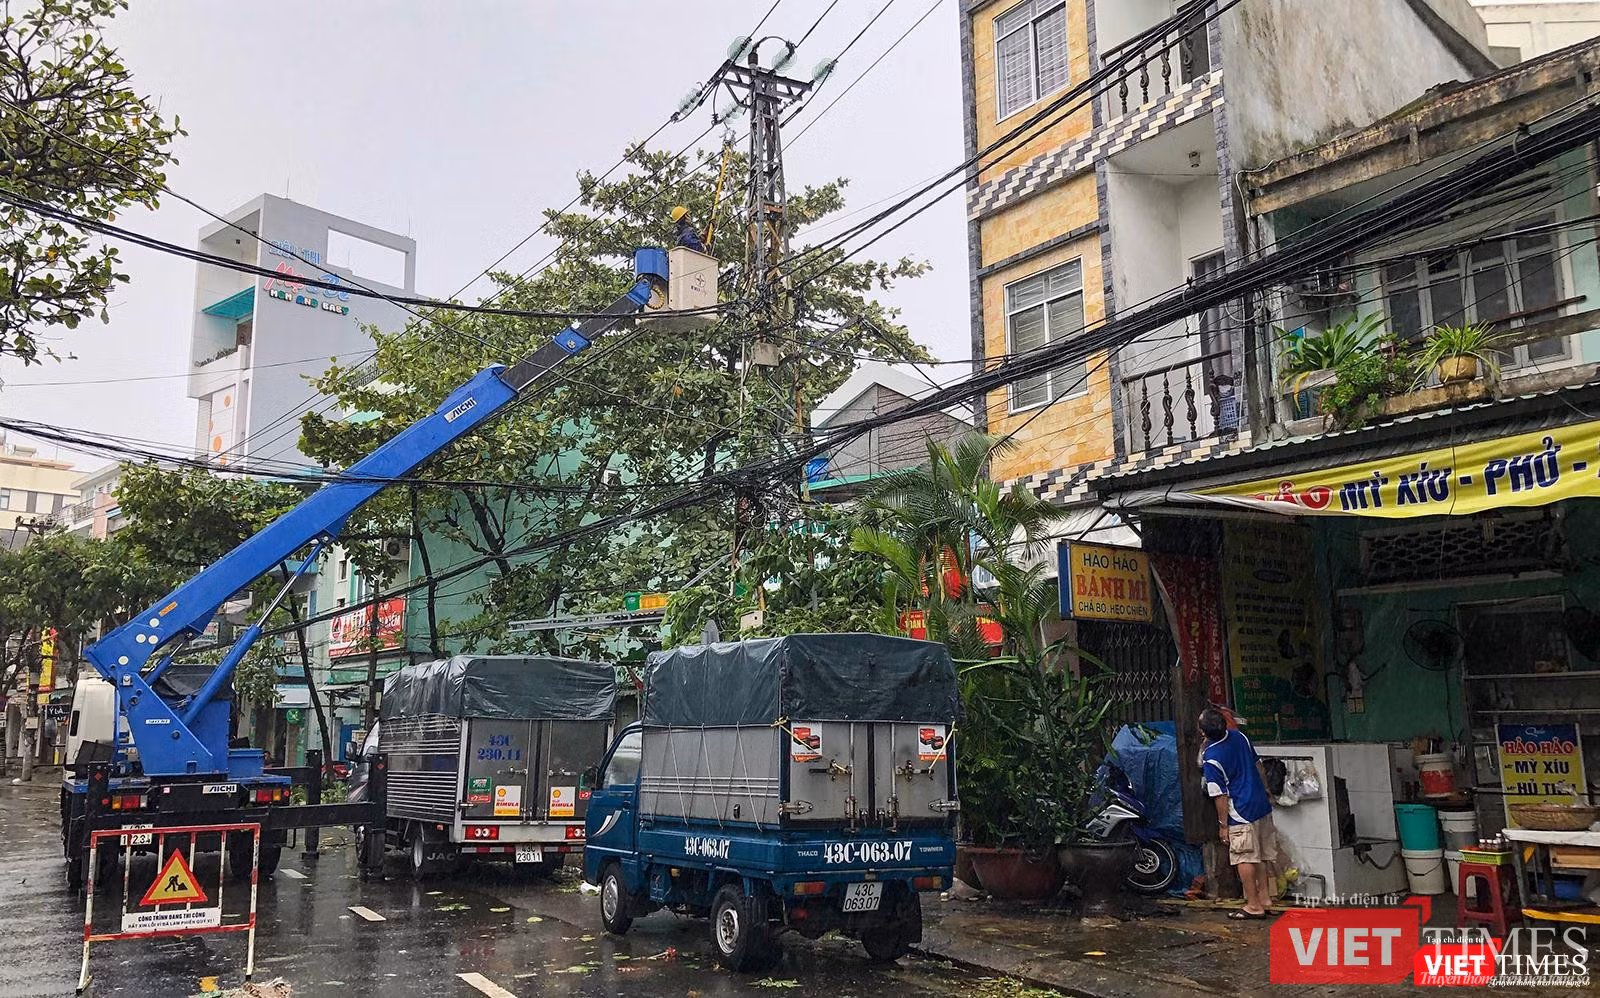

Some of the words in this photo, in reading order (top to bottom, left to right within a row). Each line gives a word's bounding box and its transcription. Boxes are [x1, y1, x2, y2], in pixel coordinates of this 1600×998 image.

[269, 289, 293, 302] MOM
[296, 295, 319, 308] AND
[322, 302, 349, 316] BABY
[447, 399, 476, 420] AICHI
[1397, 463, 1452, 506] XÍU
[1486, 436, 1562, 496] PHỞ
[478, 748, 521, 760] 230.11
[1515, 759, 1538, 774] MỲ
[1543, 759, 1569, 774] XÍU
[207, 785, 236, 793] AICHI
[1517, 778, 1538, 795] HỦ
[684, 837, 730, 859] 43C-063.07
[824, 841, 912, 864] 43C-063.07
[855, 884, 875, 896] 43C
[844, 897, 879, 910] 063.07
